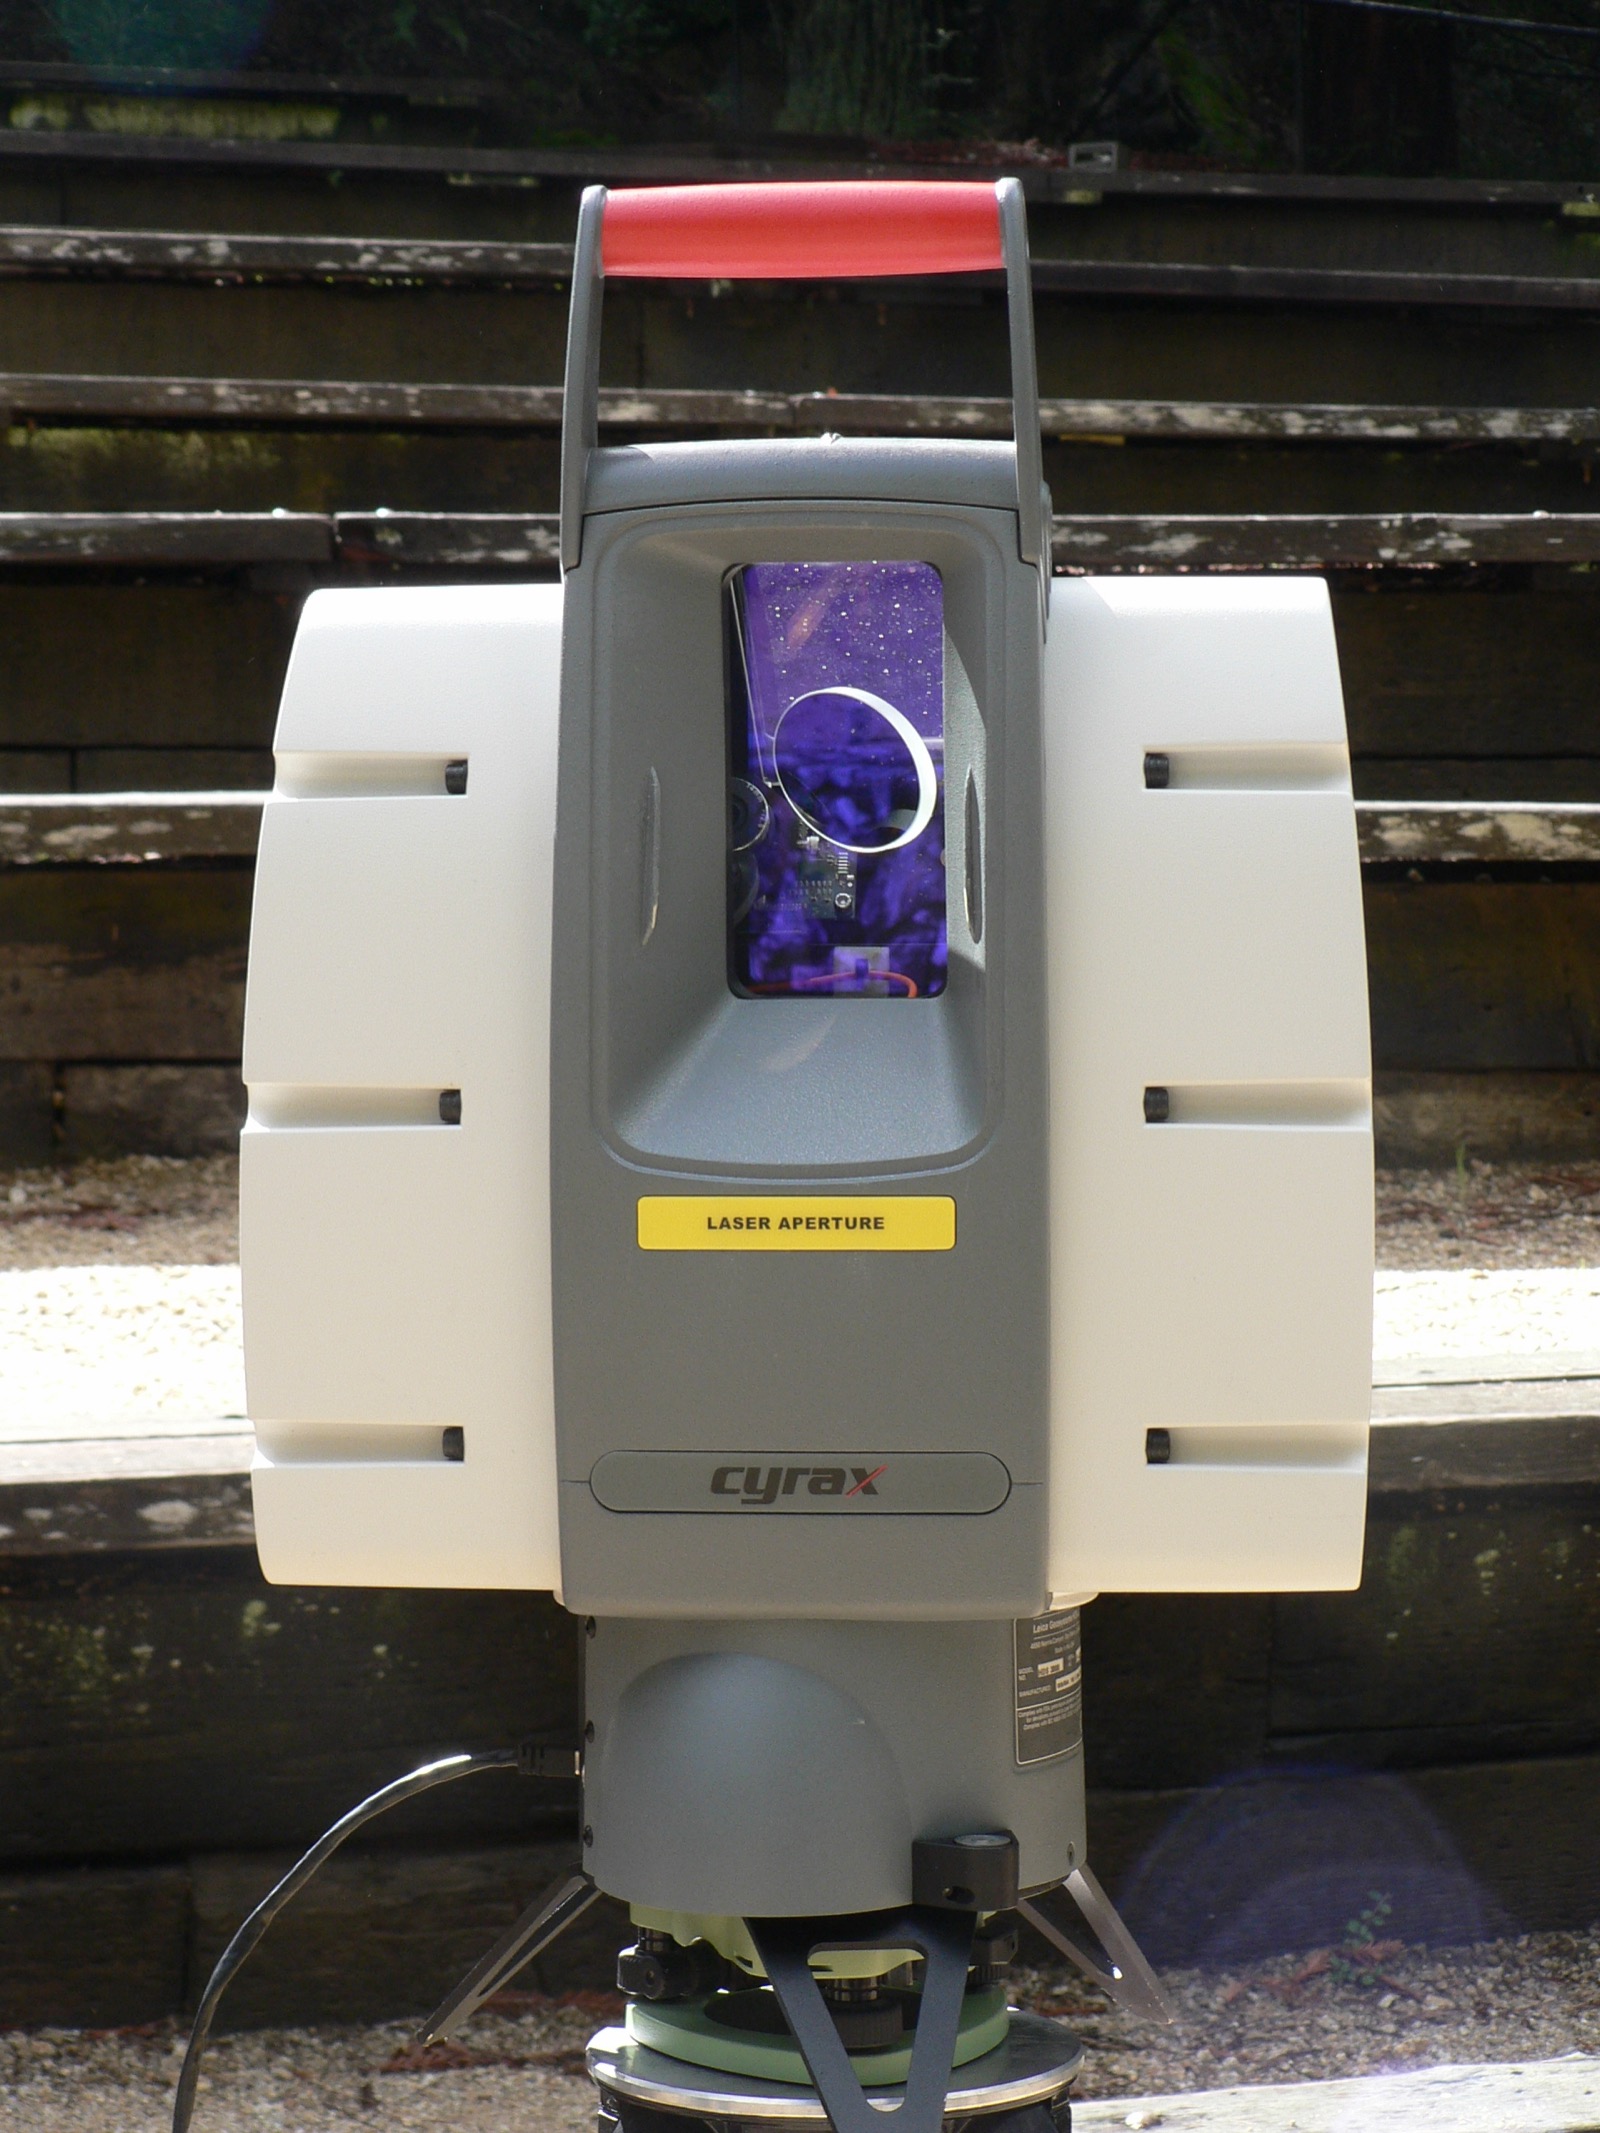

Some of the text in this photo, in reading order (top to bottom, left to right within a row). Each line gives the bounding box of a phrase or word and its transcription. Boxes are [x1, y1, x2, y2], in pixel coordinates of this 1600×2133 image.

[707, 1216, 885, 1230] LASER APERTURE
[710, 1463, 888, 1505] cyrax
[1033, 1624, 1048, 1633] Leica
